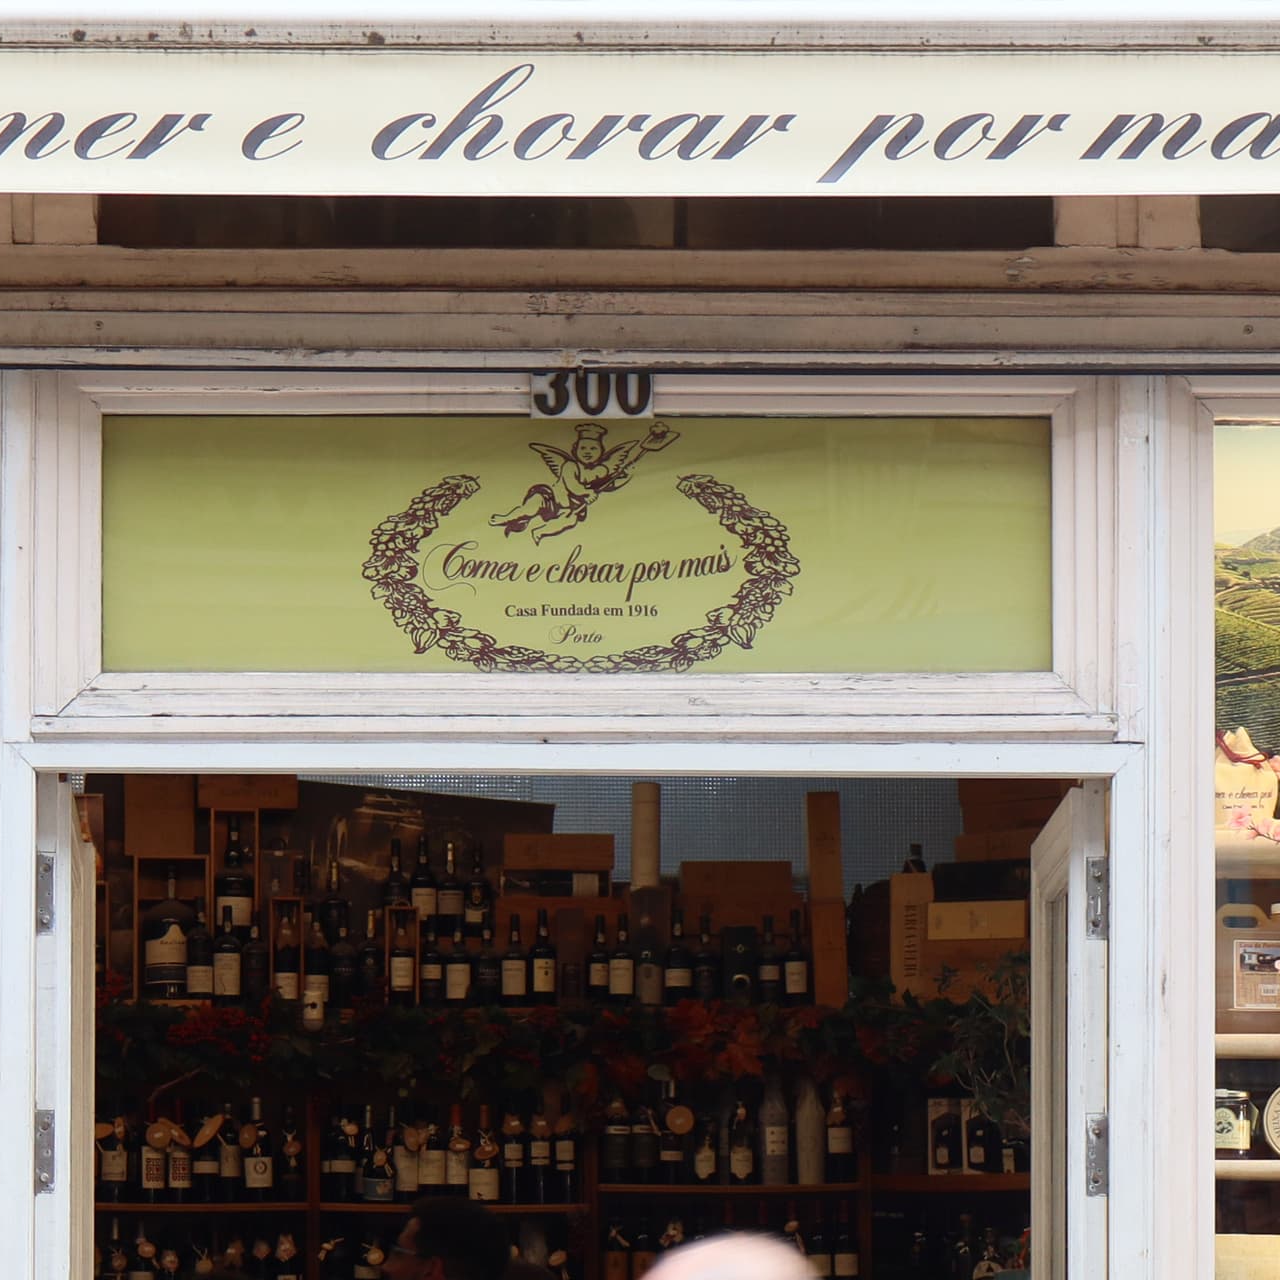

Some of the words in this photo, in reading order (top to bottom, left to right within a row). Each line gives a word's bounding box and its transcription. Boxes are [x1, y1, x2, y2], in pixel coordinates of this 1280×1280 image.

[240, 110, 306, 161] e
[370, 63, 797, 161] chorar
[816, 113, 1071, 183] por
[533, 372, 653, 416] 300
[422, 541, 524, 597] Comer
[526, 564, 543, 583] e
[545, 545, 625, 585] chorar
[625, 561, 675, 601] por
[677, 543, 738, 579] mais
[504, 604, 538, 618] Casa
[540, 603, 601, 618] Fundada
[603, 606, 624, 617] em
[627, 604, 659, 618] 1916
[548, 623, 604, 646] Porto
